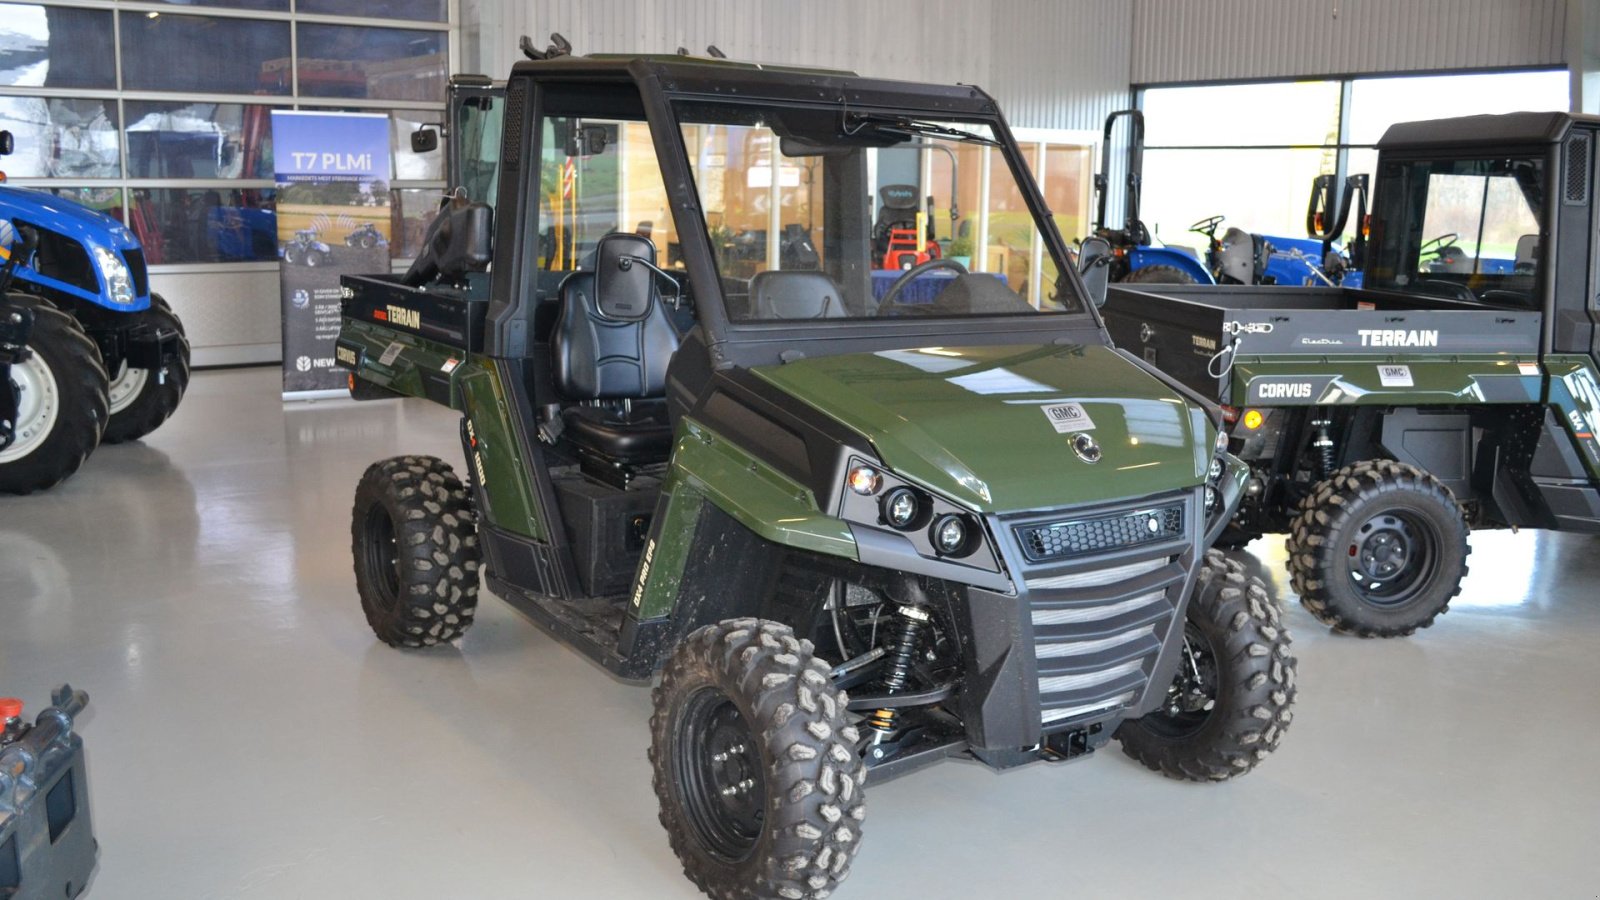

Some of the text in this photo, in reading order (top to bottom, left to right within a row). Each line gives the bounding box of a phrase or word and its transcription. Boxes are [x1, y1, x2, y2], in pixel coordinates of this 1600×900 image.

[291, 151, 371, 171] T7 PLMi
[386, 304, 420, 330] TERRAIN
[1191, 335, 1217, 350] TERRAIN
[1357, 329, 1439, 347] TERRAIN
[313, 358, 335, 368] NEW
[1384, 367, 1404, 377] GMC
[1258, 383, 1312, 398] CORVUS
[1052, 407, 1077, 419] GMC
[633, 538, 656, 608] DX4 PRO EPS
